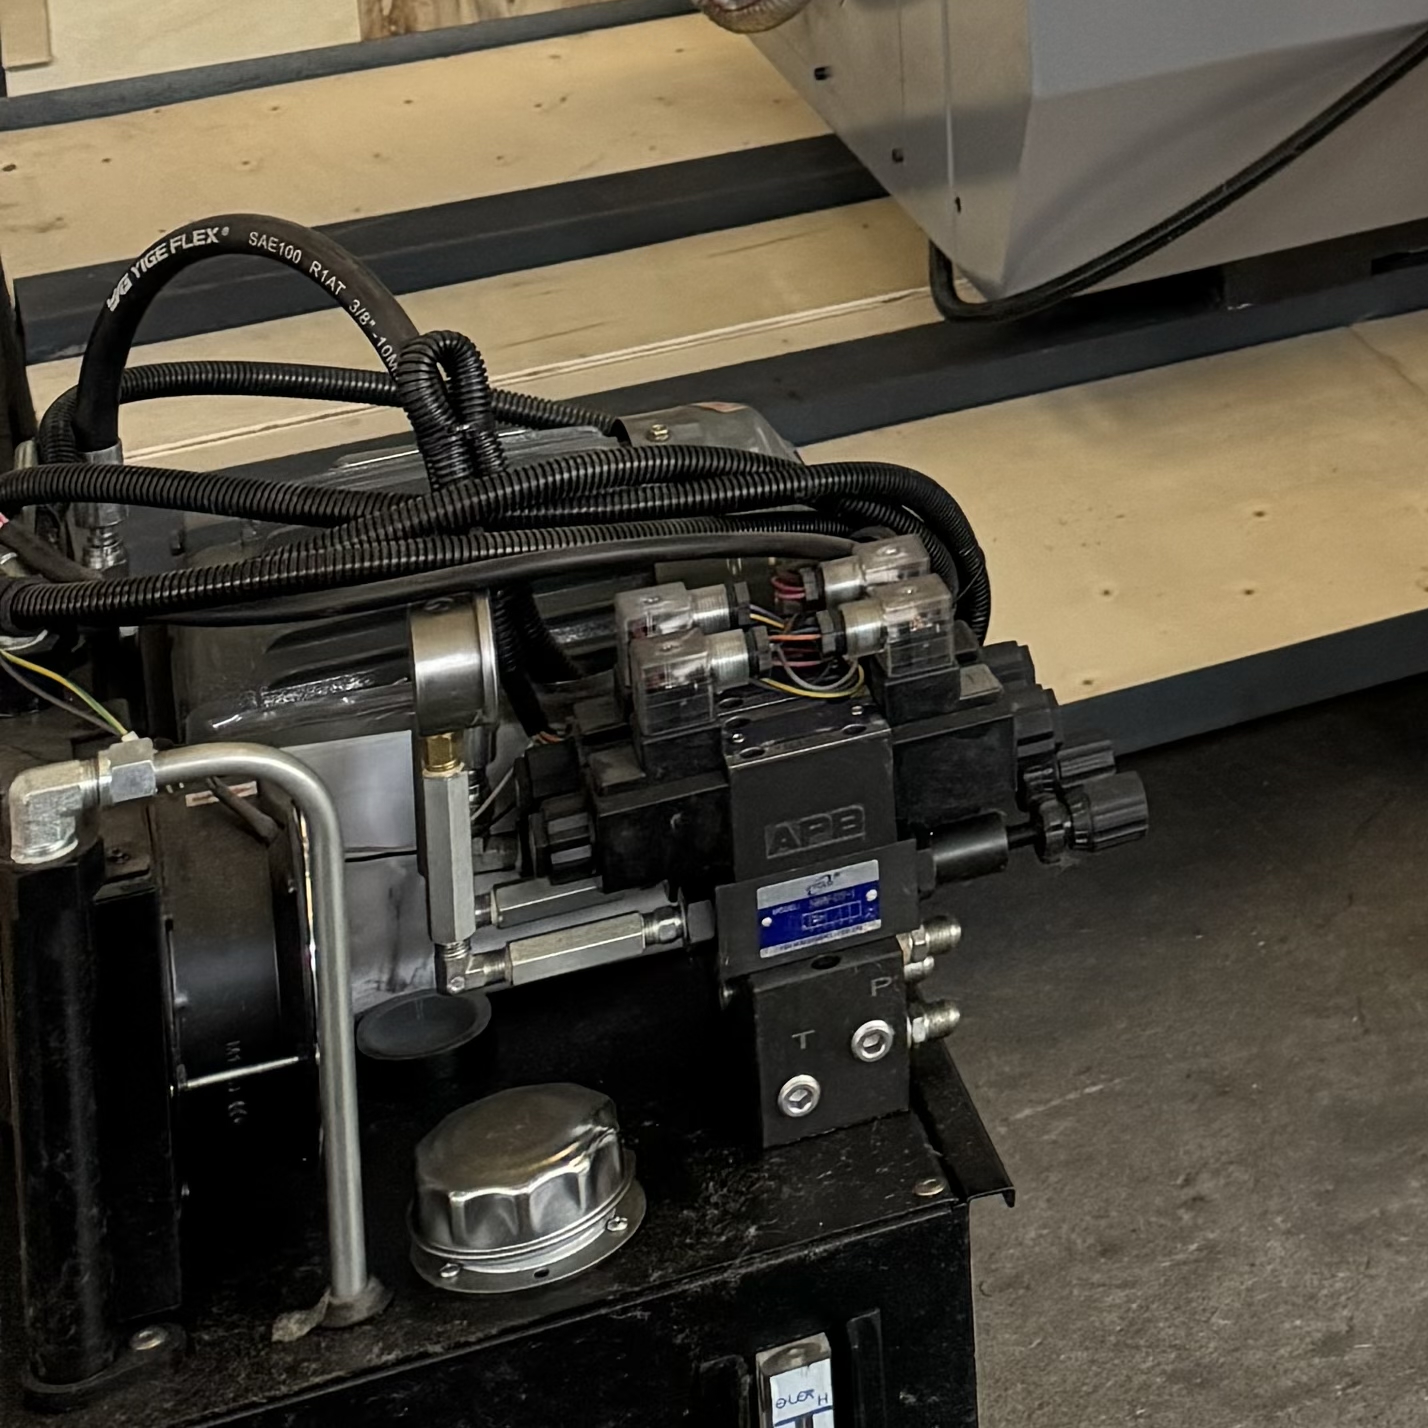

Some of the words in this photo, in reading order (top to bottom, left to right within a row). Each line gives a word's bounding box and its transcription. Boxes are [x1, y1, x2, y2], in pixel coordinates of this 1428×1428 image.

[130, 242, 169, 280] YIGE
[248, 231, 302, 264] SAE100
[309, 260, 347, 295] R1AT
[871, 976, 893, 997] P
[791, 1029, 816, 1050] T
